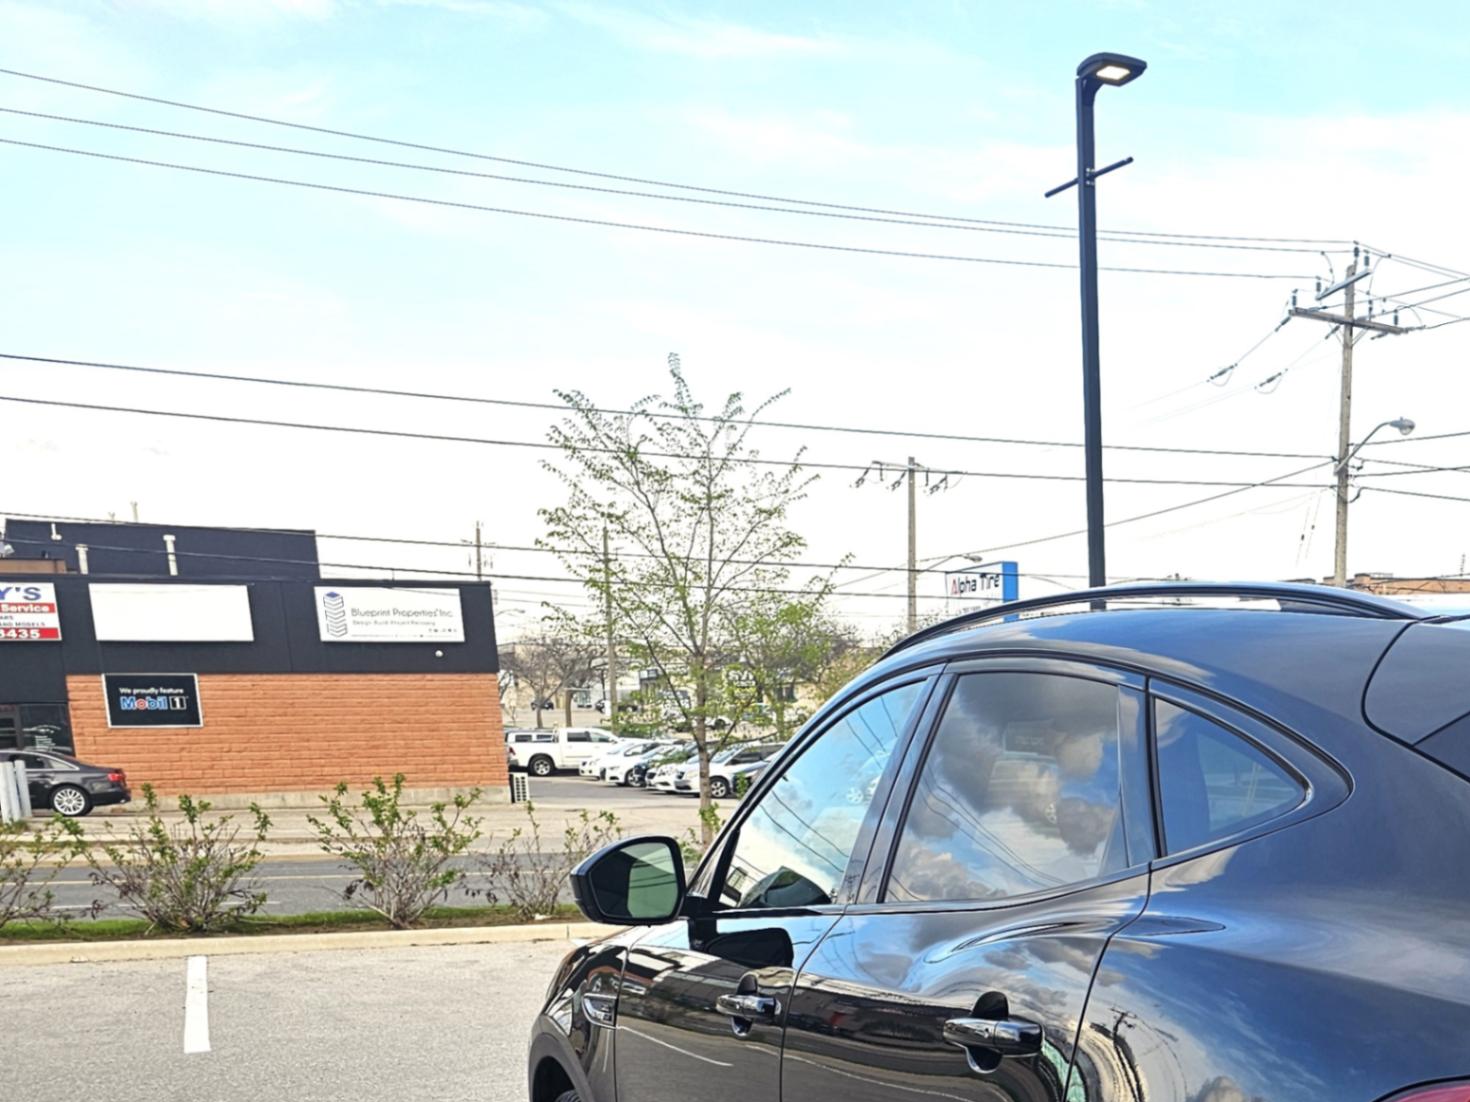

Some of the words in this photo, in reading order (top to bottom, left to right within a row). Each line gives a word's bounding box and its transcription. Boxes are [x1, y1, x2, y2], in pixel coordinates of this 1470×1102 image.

[951, 575, 977, 596] Alpha
[980, 572, 1000, 590] Tire
[1, 603, 49, 613] Service
[351, 608, 390, 618] Blueprint
[120, 696, 168, 710] Mobil
